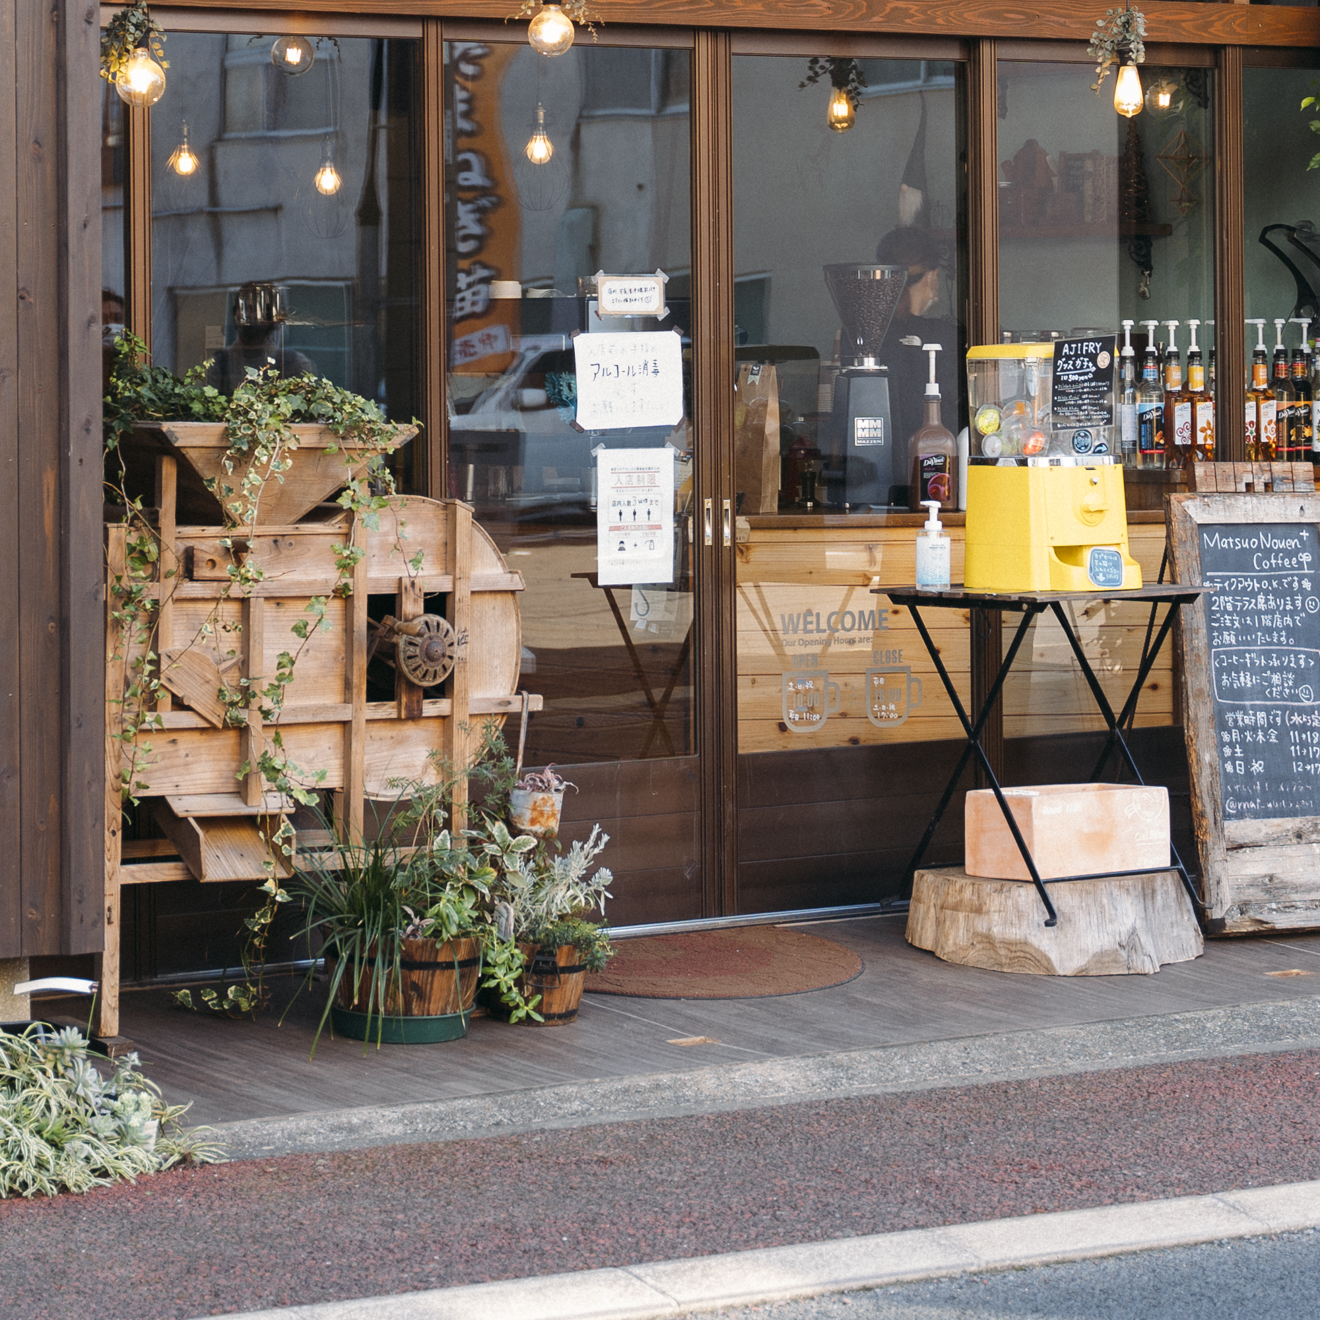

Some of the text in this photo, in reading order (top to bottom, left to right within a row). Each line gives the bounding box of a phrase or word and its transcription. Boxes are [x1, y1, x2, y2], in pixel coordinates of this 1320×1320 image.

[1062, 342, 1102, 356] AJIFRY
[590, 358, 660, 382] アルコール消毒
[1203, 532, 1258, 550] Matsuo
[1253, 552, 1299, 570] Coffee
[1211, 592, 1303, 611] 2階テラス席あります
[781, 609, 889, 635] WELCOME
[782, 639, 796, 647] Our
[798, 637, 832, 648] Opening
[833, 636, 856, 645] Hours
[792, 653, 818, 668] OPEN
[873, 649, 903, 665] CLOSE
[1234, 744, 1244, 757] 土
